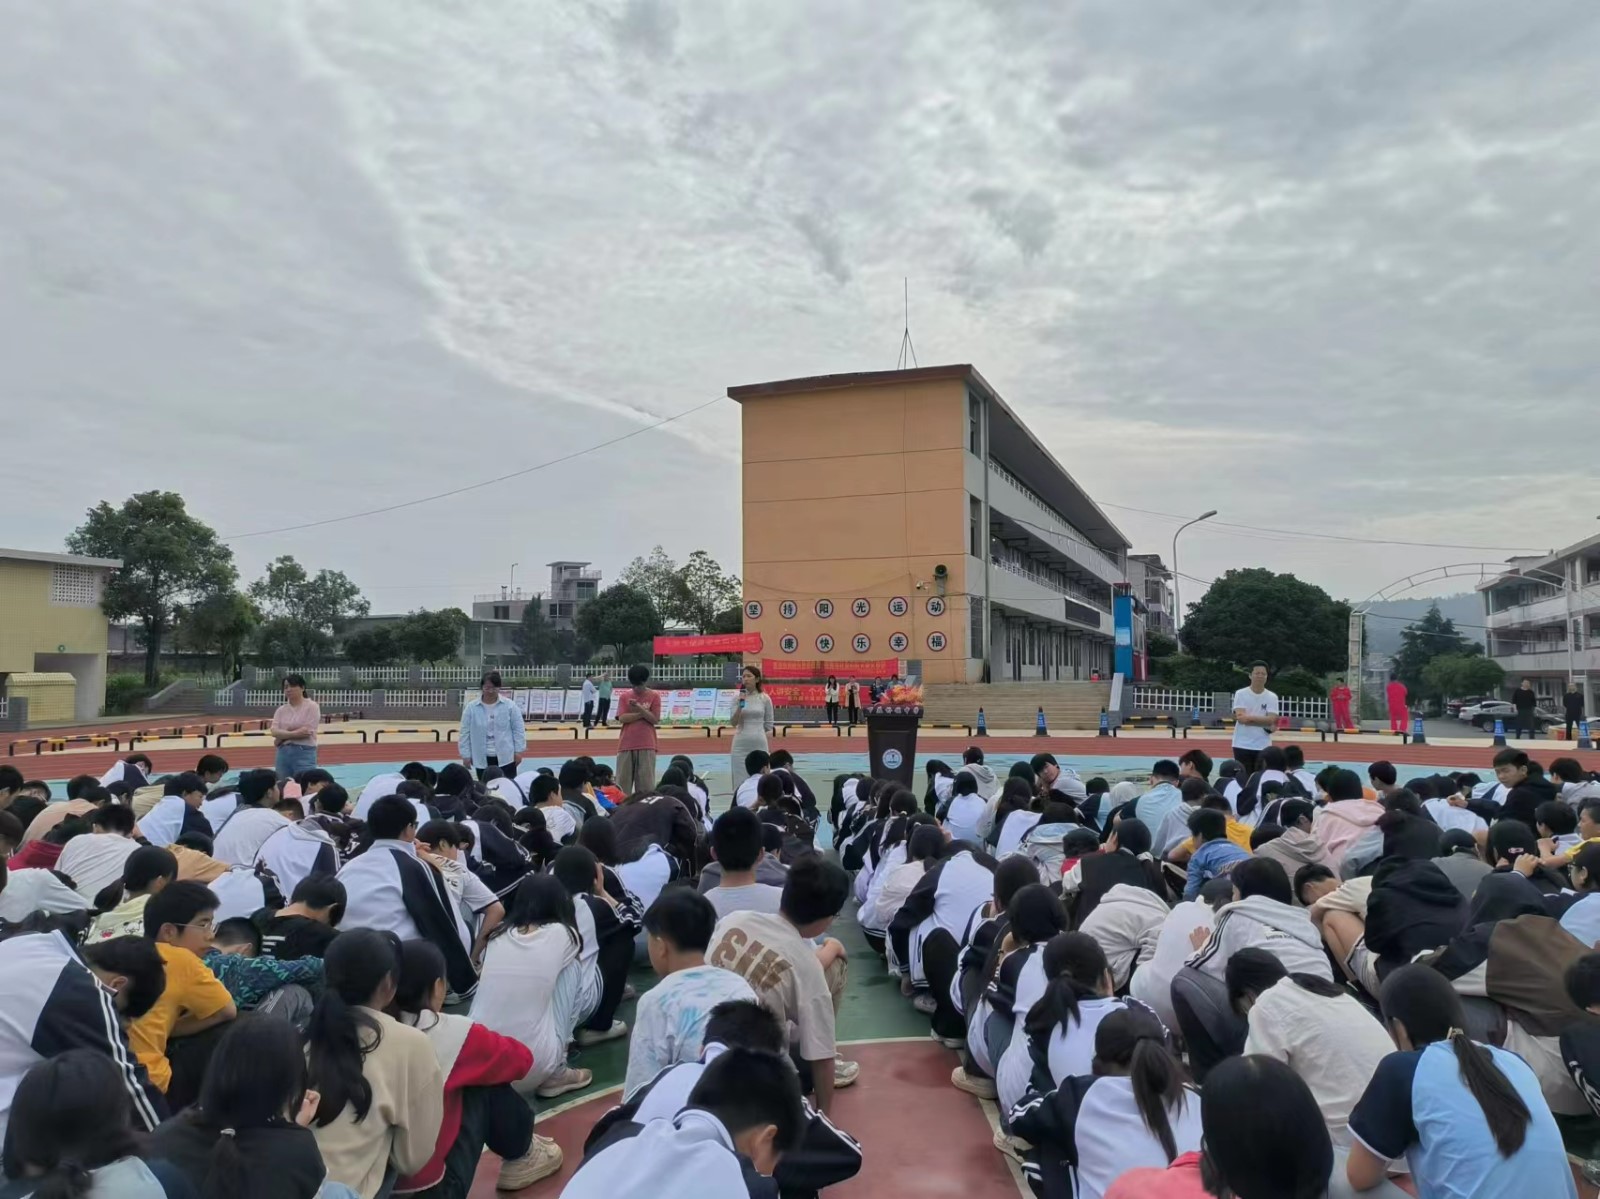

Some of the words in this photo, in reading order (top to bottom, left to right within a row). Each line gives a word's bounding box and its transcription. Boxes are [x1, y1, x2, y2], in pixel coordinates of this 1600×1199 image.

[748, 600, 942, 616] 坚持阳光运动
[783, 635, 943, 650] 康快乐幸福
